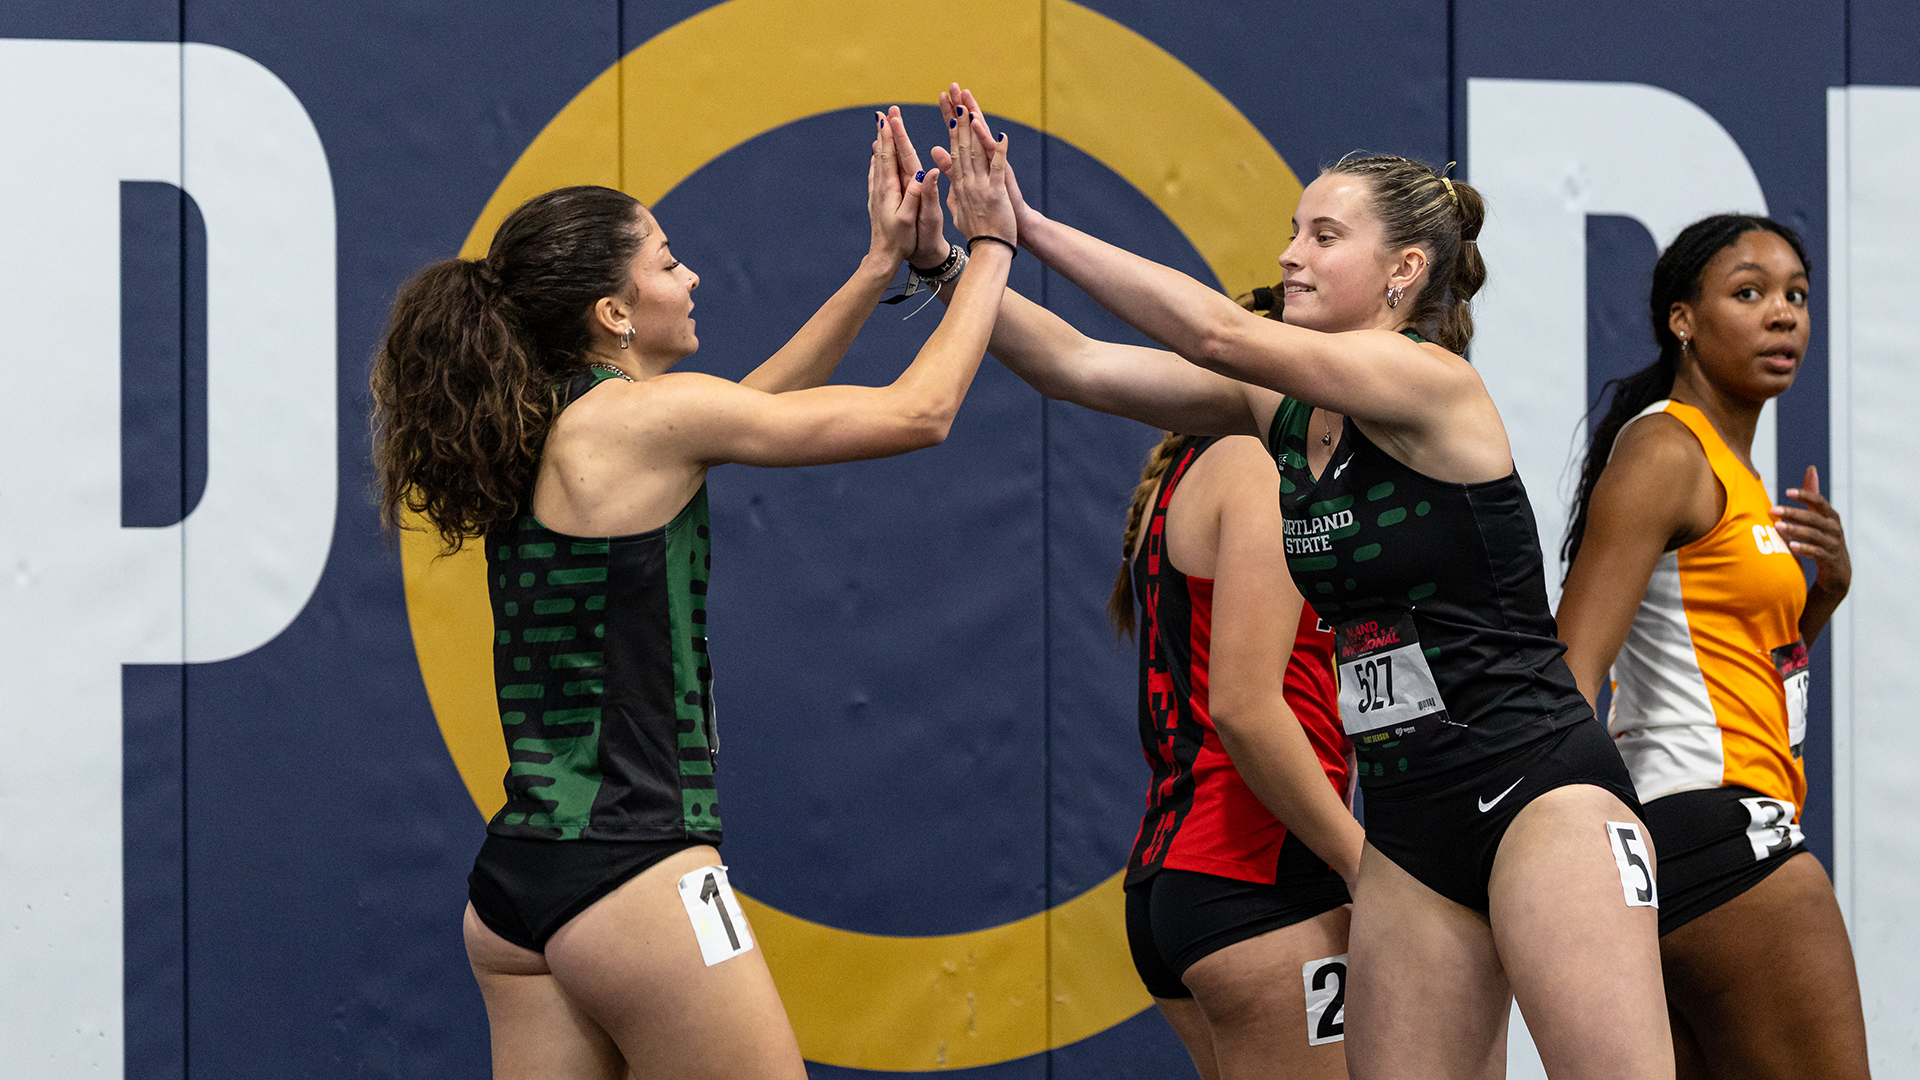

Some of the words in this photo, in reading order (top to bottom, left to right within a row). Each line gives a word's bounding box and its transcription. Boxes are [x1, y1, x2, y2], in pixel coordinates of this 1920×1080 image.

[1282, 509, 1354, 536] ORTLAND
[1285, 534, 1333, 554] STATE
[1354, 655, 1395, 713] 527
[1756, 801, 1792, 855] 3
[1616, 828, 1653, 903] 5
[700, 872, 741, 951] 1
[1312, 962, 1347, 1039] 2
